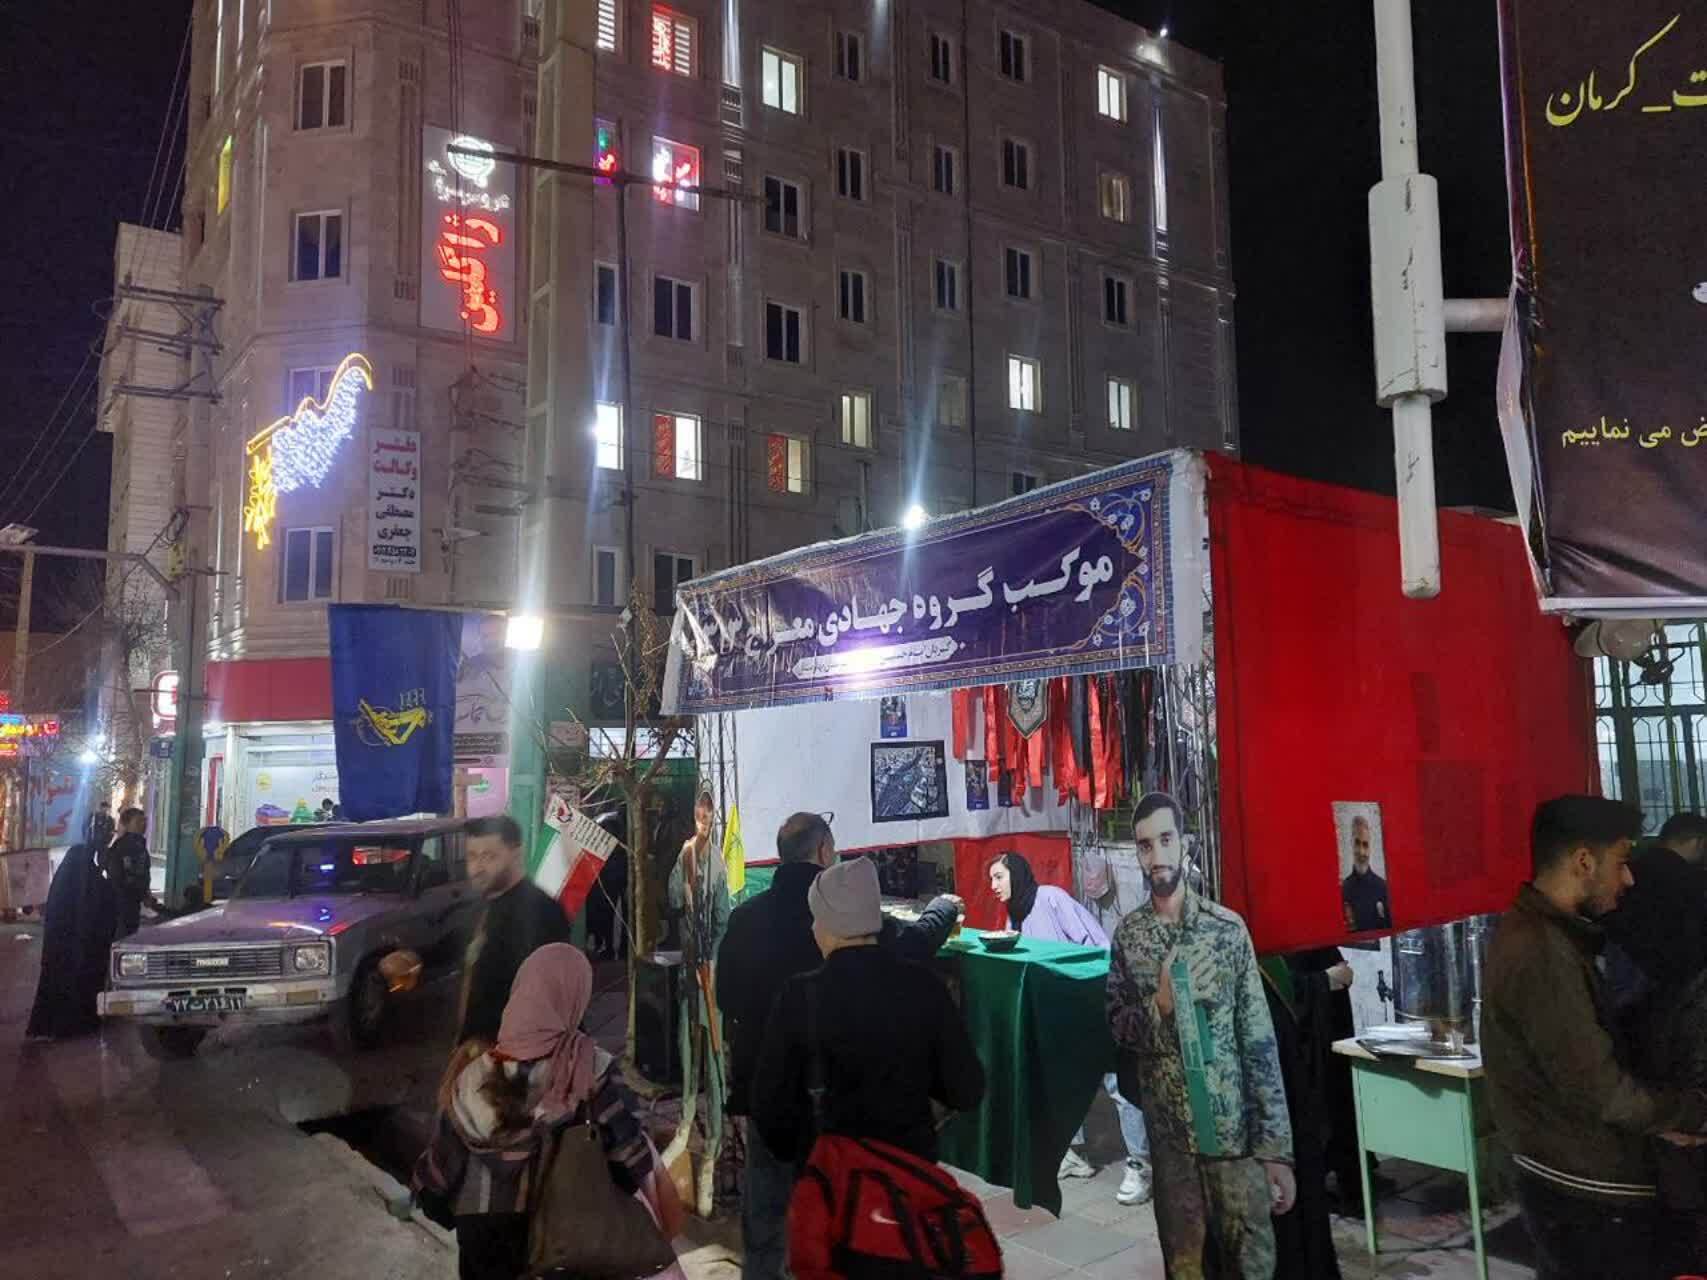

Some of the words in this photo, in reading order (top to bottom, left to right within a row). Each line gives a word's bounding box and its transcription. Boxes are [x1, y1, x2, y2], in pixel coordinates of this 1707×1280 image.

[1561, 415, 1631, 449] نماییم
[1638, 425, 1672, 449] می
[374, 458, 417, 480] وکالت
[376, 487, 416, 501] دکتر
[1002, 546, 1113, 614] موکب
[911, 565, 994, 631] گروه
[816, 593, 908, 647] جهادی
